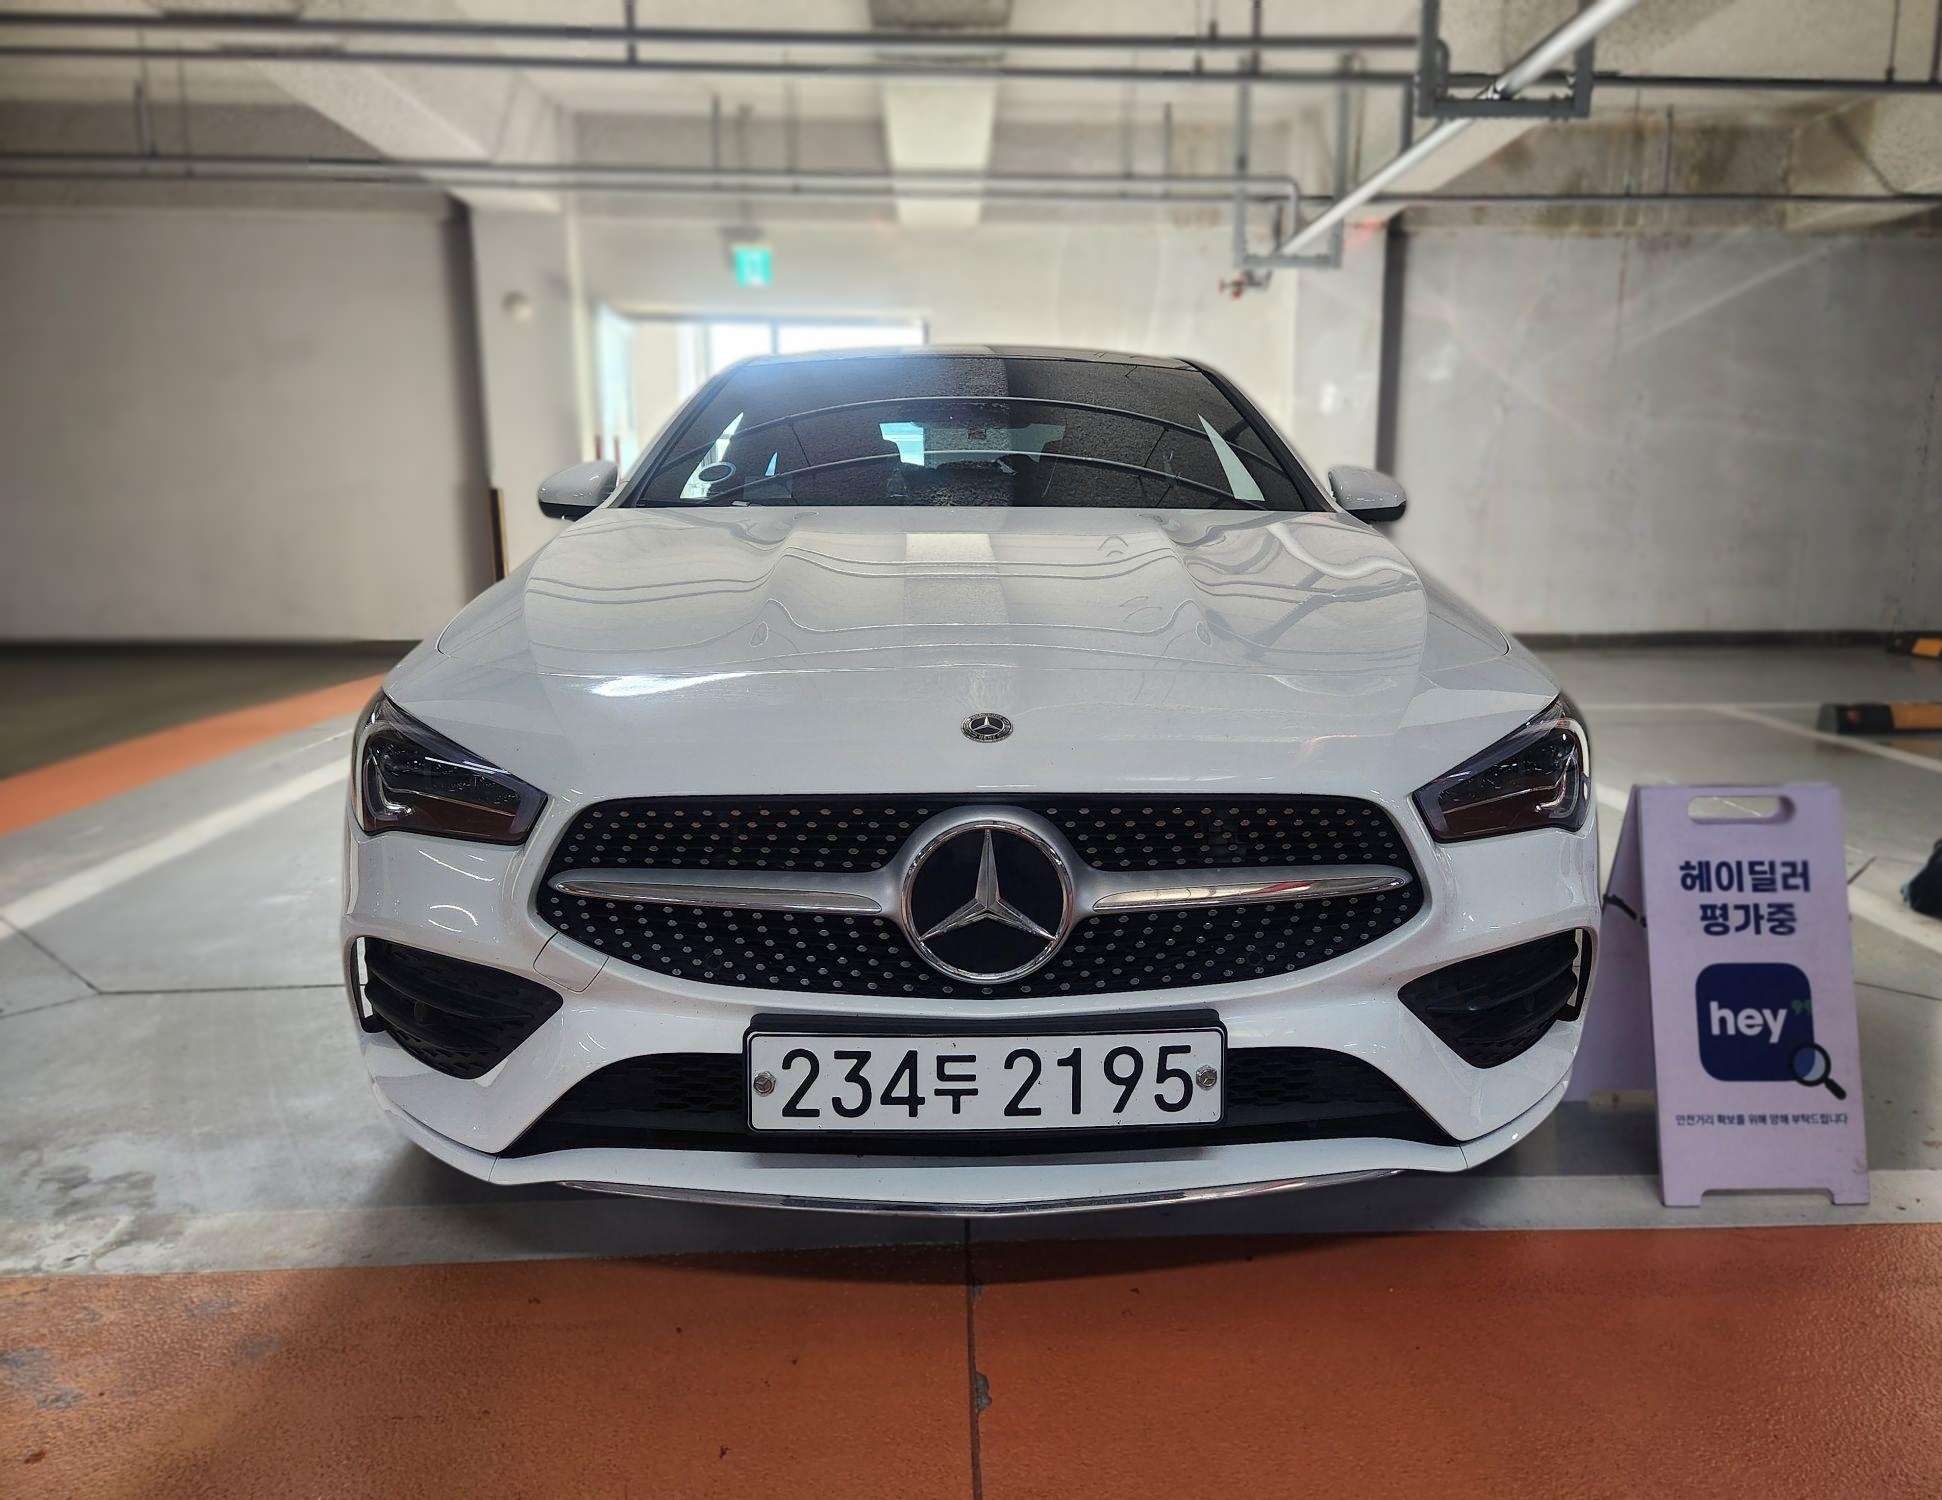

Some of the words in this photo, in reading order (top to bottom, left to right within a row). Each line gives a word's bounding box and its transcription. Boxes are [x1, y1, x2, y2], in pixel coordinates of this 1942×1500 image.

[1679, 859, 1811, 893] 헤이딜러
[1699, 902, 1798, 937] 평가중
[1709, 1000, 1788, 1044] hey
[781, 1048, 979, 1118] 234두
[1003, 1044, 1194, 1117] 2195
[1675, 1113, 1715, 1127] 안전거리
[1716, 1113, 1746, 1126] 확보를
[1747, 1113, 1768, 1126] 위해
[1769, 1113, 1790, 1126] 양해
[1791, 1112, 1848, 1126] 부탁드립니다
